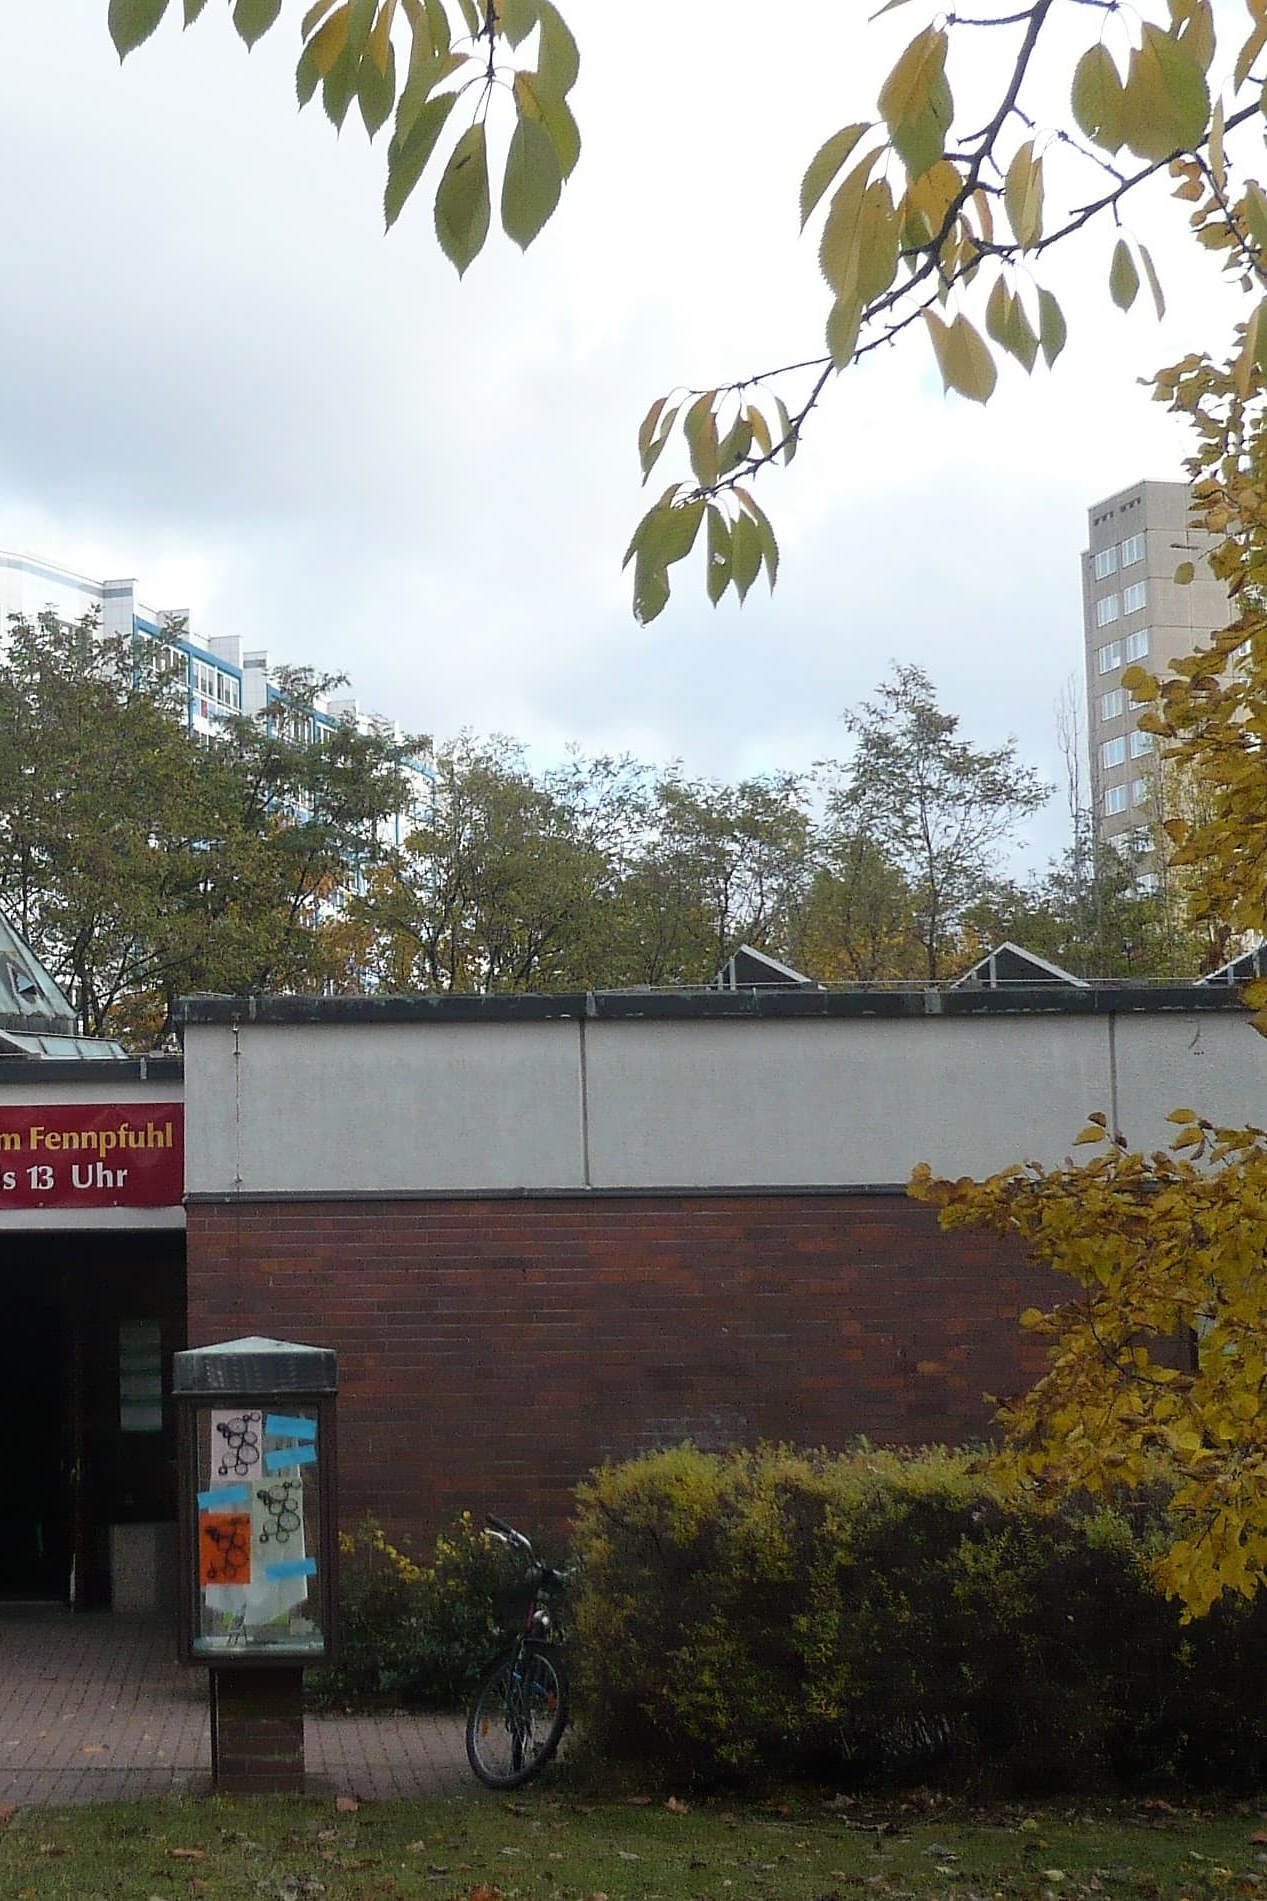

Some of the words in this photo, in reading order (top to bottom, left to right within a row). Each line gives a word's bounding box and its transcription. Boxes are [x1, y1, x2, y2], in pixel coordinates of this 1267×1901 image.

[29, 1122, 173, 1157] Fennpfuhl
[26, 1165, 55, 1189] 13
[72, 1162, 129, 1189] Uhr
